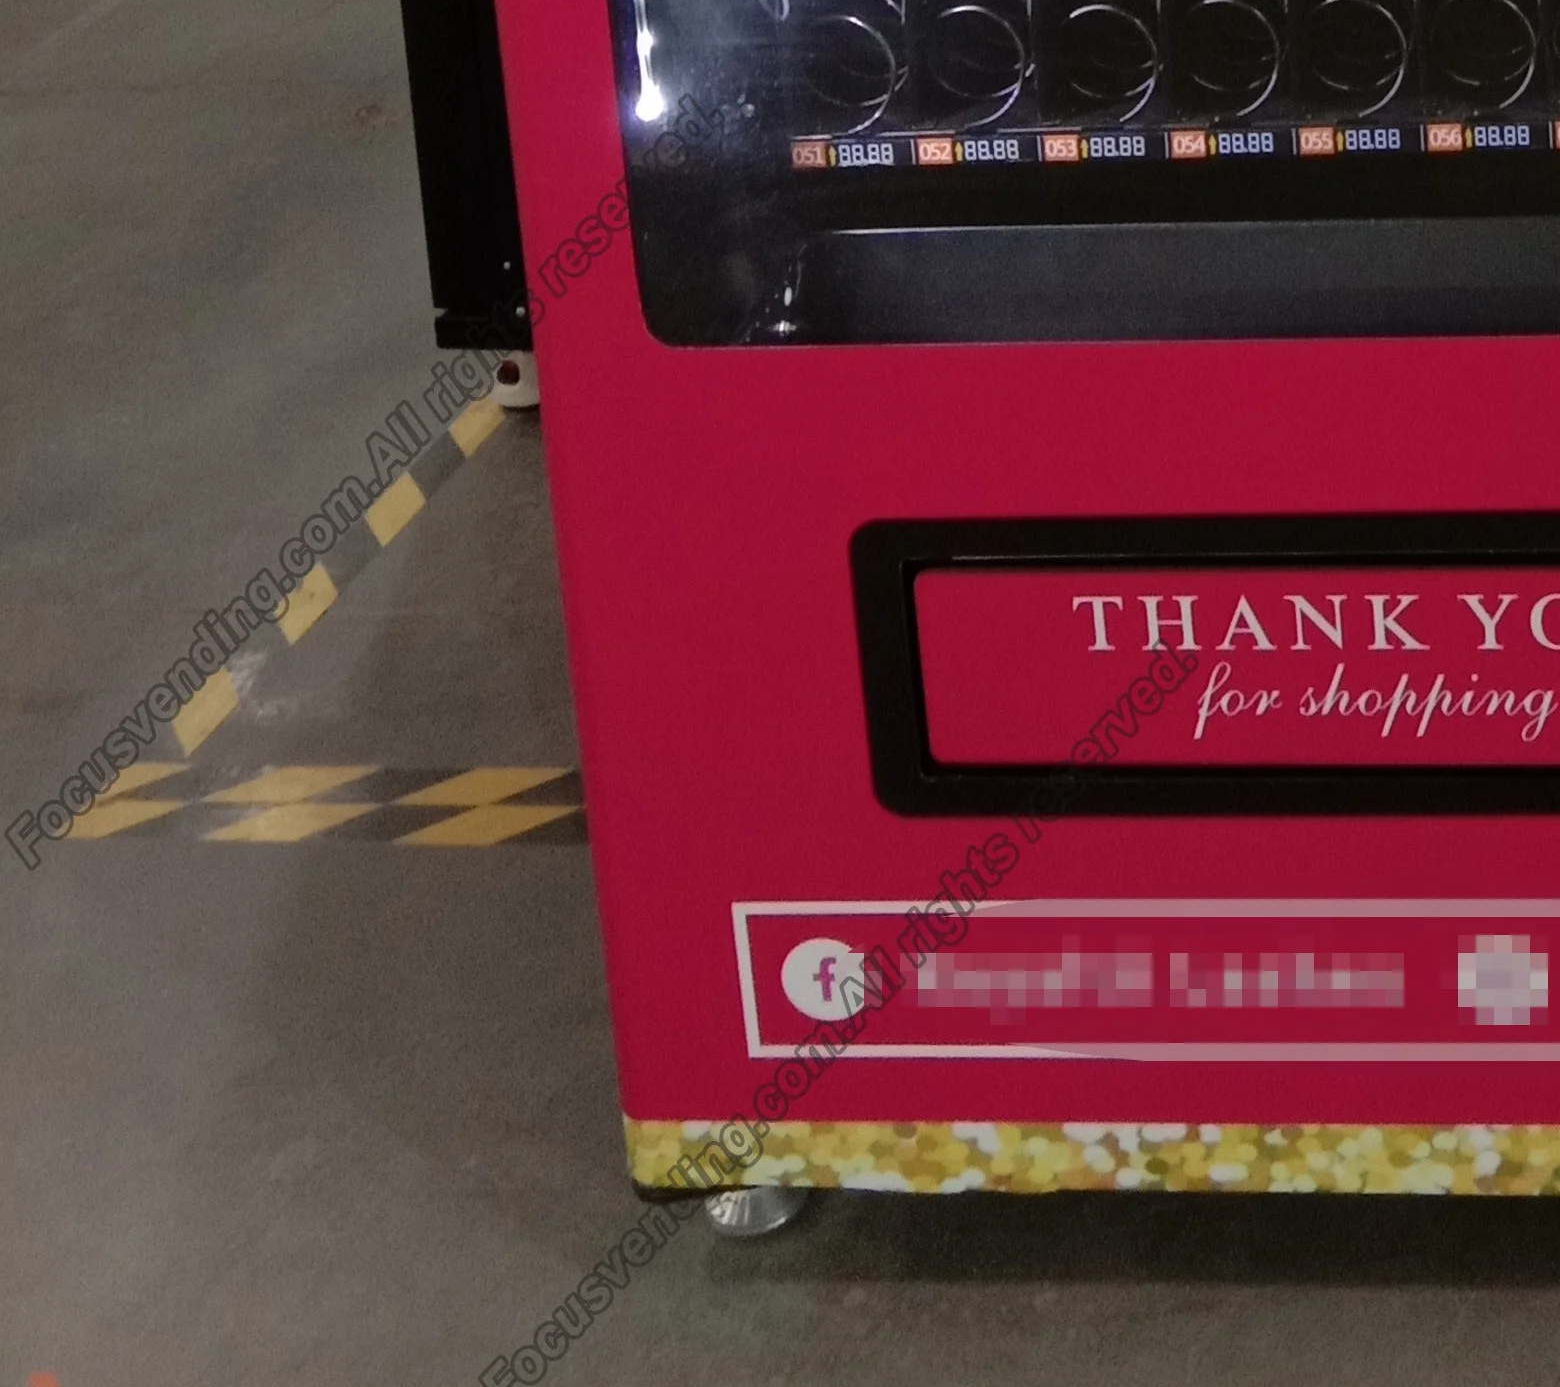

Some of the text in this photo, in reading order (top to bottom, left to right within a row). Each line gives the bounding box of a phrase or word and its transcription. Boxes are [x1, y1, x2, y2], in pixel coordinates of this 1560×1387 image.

[1045, 135, 1146, 158] 053 88.88
[1172, 131, 1274, 154] 054 88.88
[1301, 128, 1401, 151] 055 88.88
[1428, 125, 1529, 147] 056 88.88
[793, 143, 893, 166] 051 88.88
[920, 138, 1019, 162] 052 88.88
[1072, 593, 1430, 654] THANK
[1193, 661, 1558, 743] for shopping
